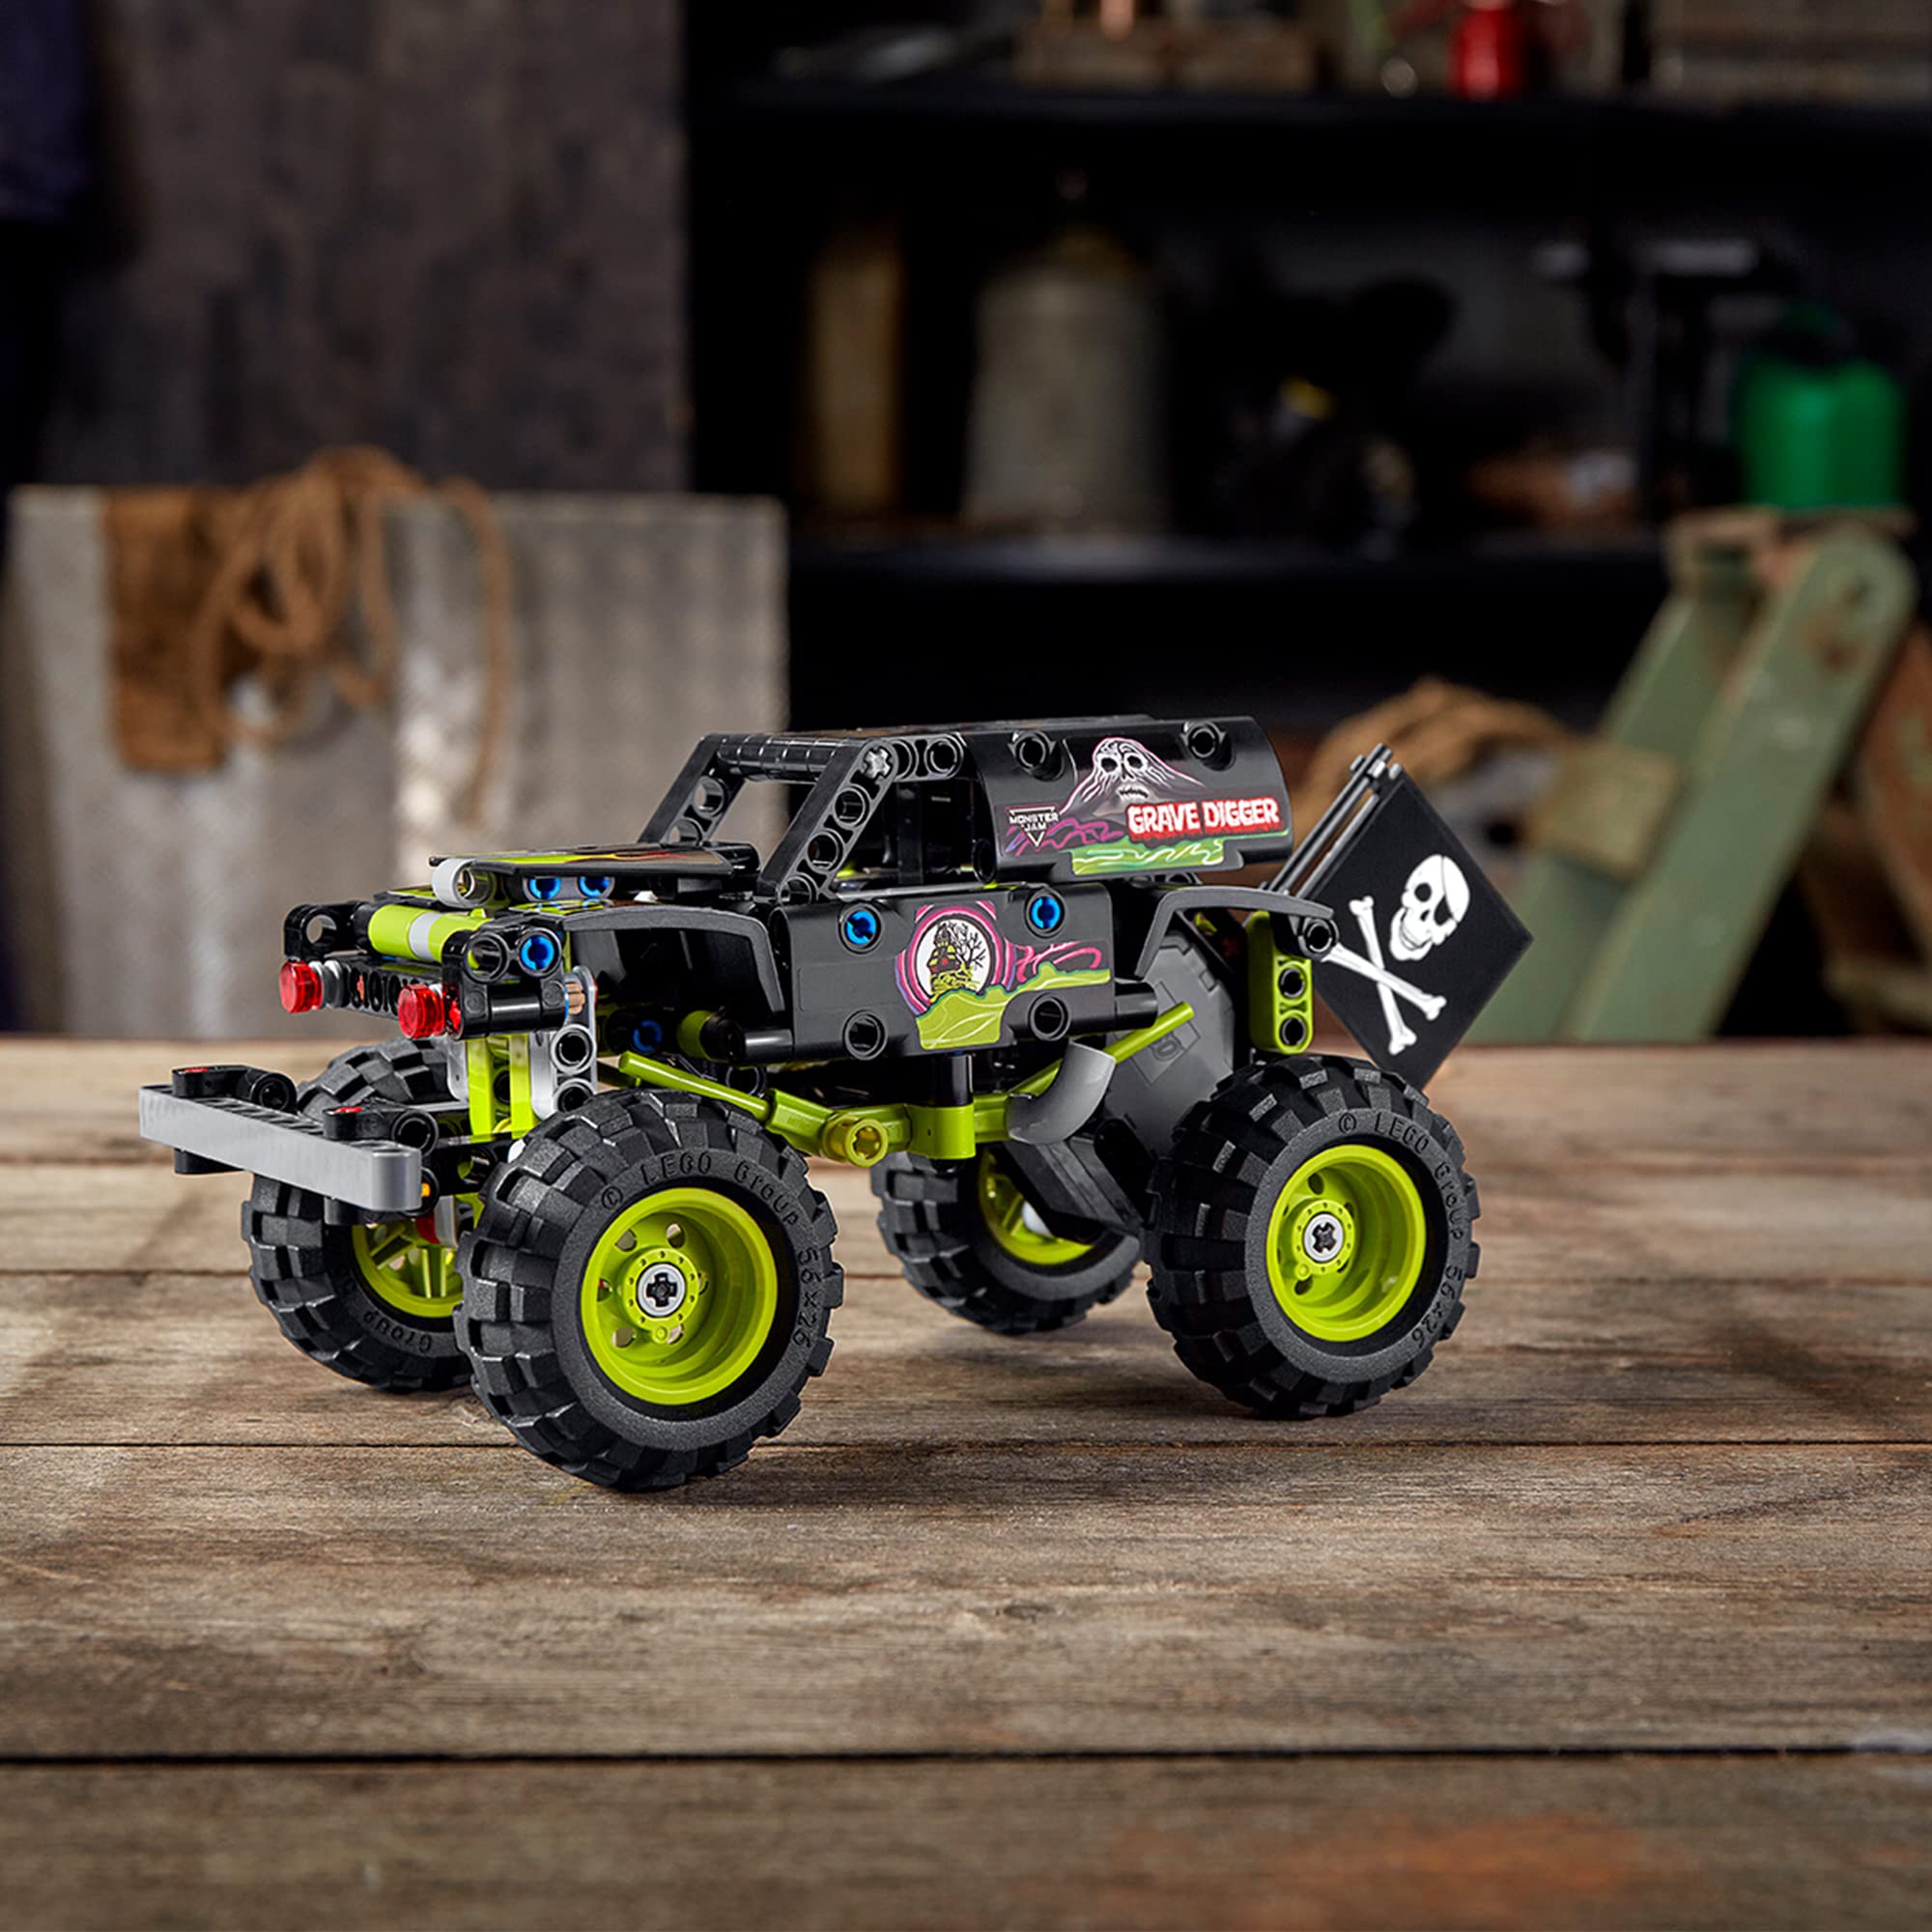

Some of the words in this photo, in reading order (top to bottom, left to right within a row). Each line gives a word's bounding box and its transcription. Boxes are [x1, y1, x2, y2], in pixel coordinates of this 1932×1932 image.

[1009, 812, 1059, 824] MONSTER
[1021, 822, 1046, 832] JAM
[1127, 802, 1201, 834] GRAVE
[1202, 798, 1280, 828] DIGGER
[640, 1151, 712, 1185] LEGO
[734, 1160, 799, 1225] Group
[1374, 1112, 1429, 1154] LEGO
[1435, 1161, 1463, 1239] Group
[363, 1310, 433, 1353] Group
